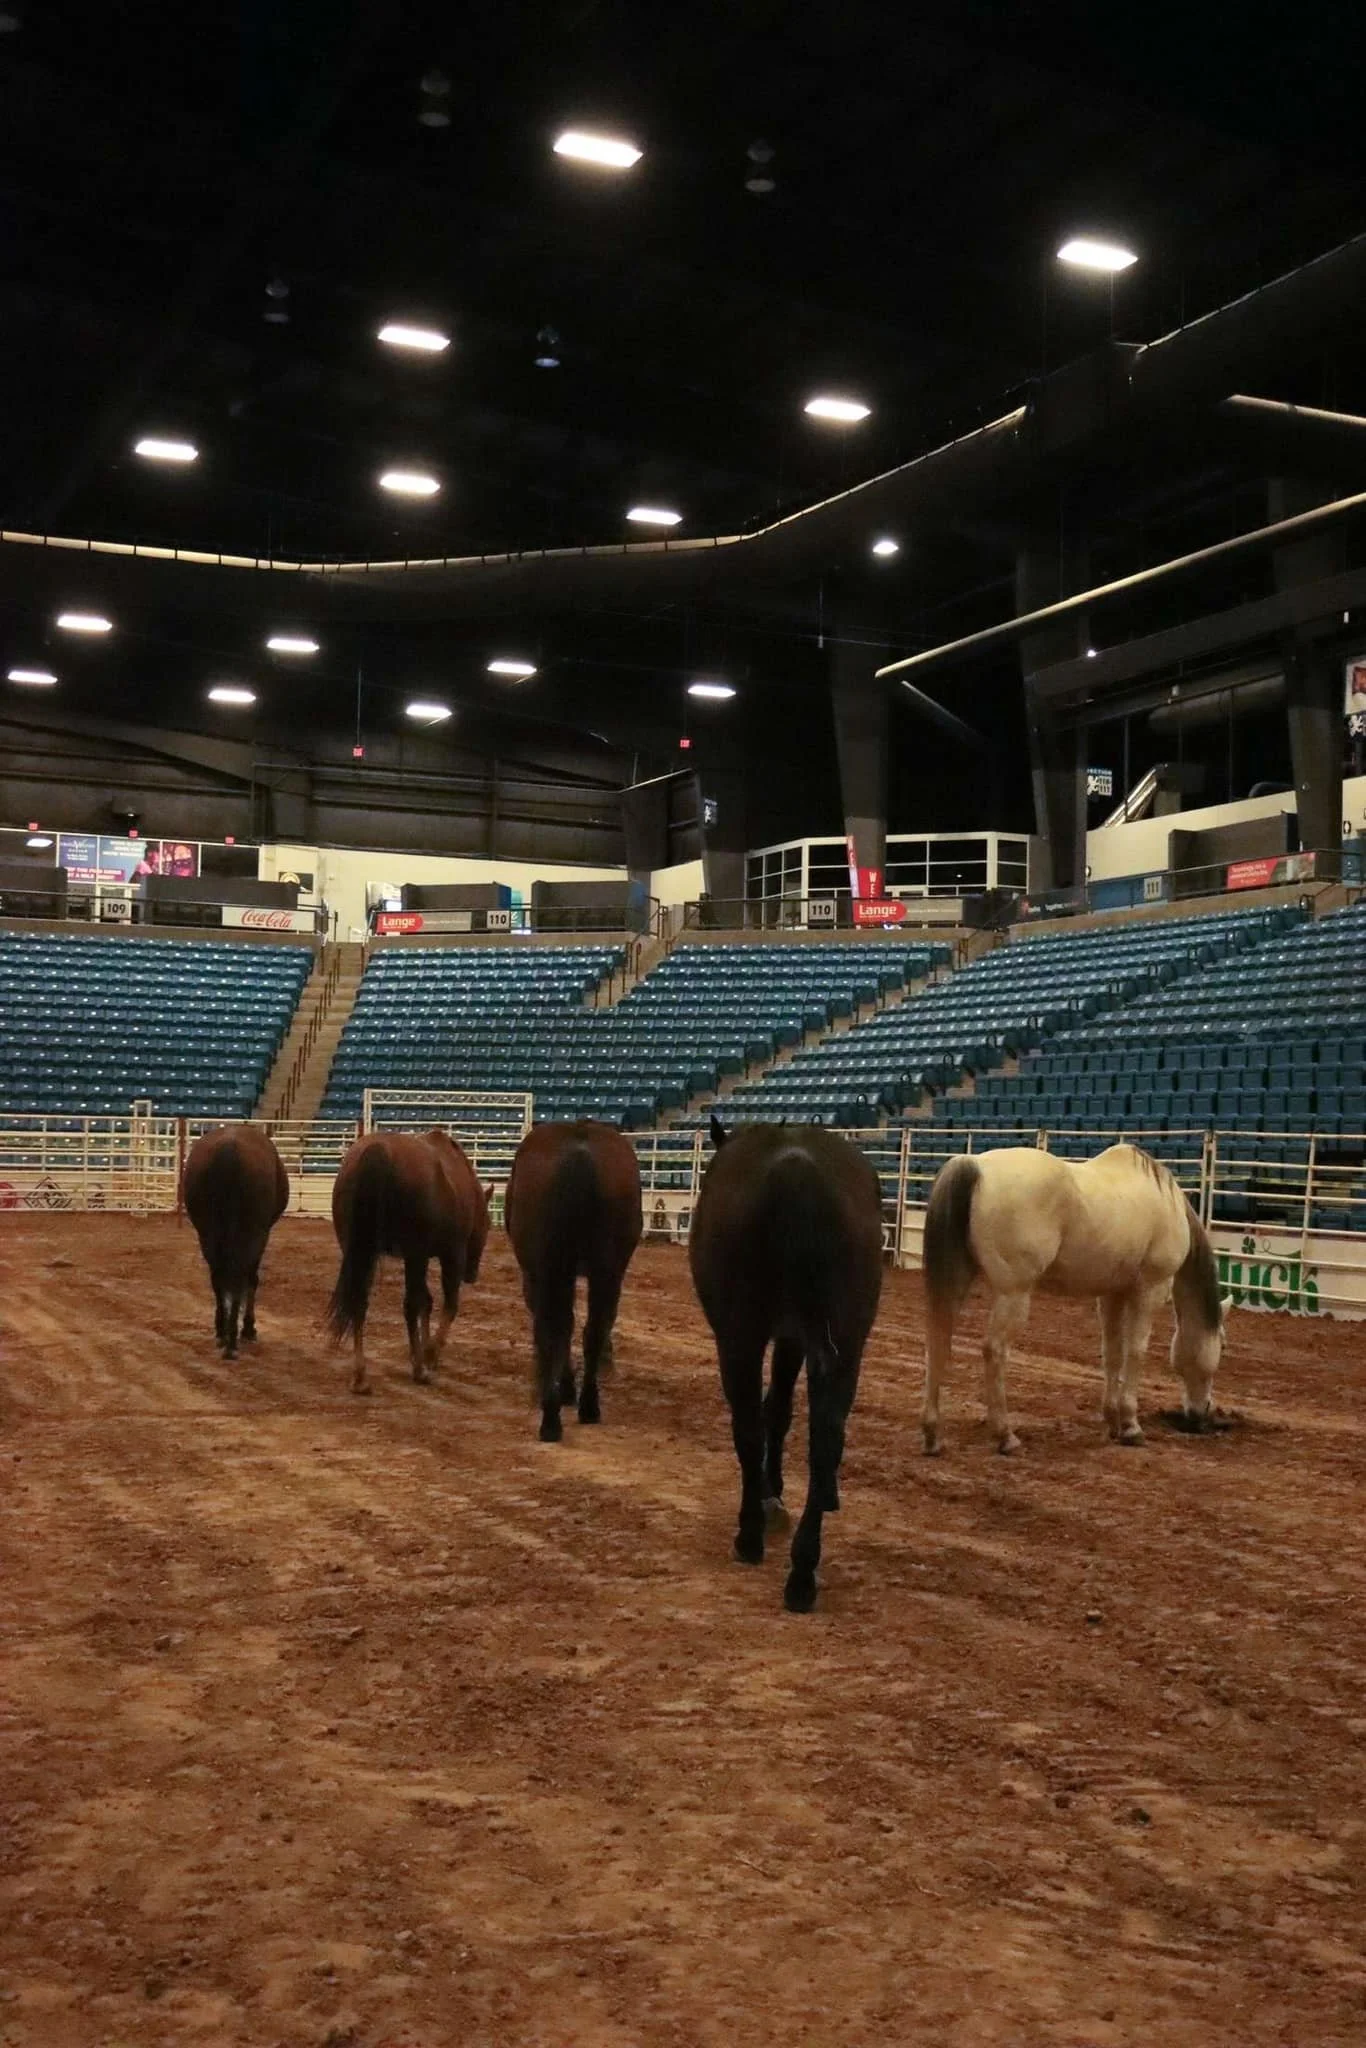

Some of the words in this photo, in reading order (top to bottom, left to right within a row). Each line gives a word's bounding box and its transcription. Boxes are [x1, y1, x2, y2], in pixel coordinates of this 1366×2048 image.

[107, 903, 126, 914] 109
[812, 905, 831, 915] 110
[859, 904, 897, 918] Lange
[382, 916, 415, 929] Lange
[489, 914, 507, 924] 110
